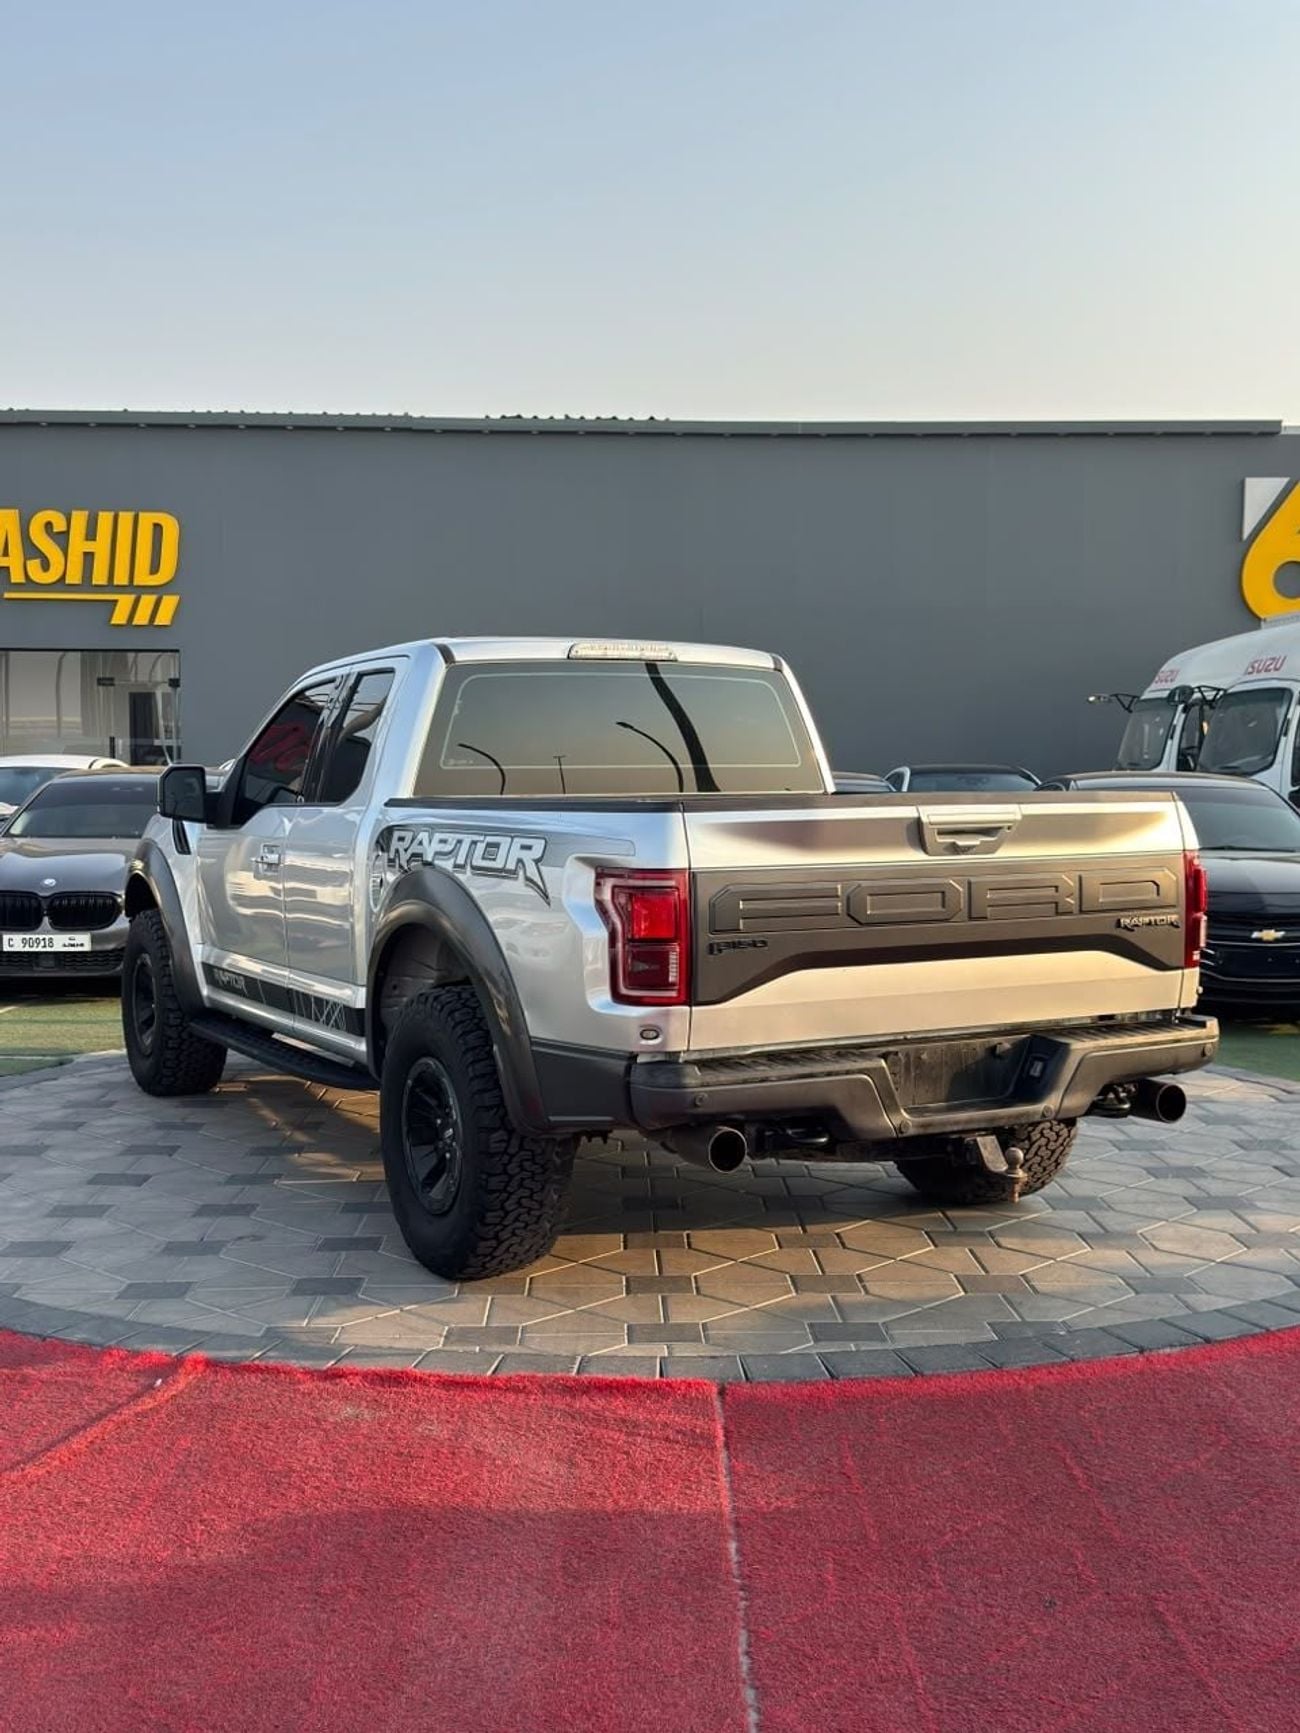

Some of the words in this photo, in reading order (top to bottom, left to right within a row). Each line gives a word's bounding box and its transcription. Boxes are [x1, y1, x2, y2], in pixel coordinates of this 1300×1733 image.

[0, 509, 180, 586] ASHID
[1243, 655, 1288, 676] ISUZU
[388, 829, 550, 901] RAPTOR
[708, 868, 1178, 935] FORD
[1115, 914, 1181, 932] RAPTOR
[8, 937, 14, 948] C
[21, 937, 54, 948] 90918
